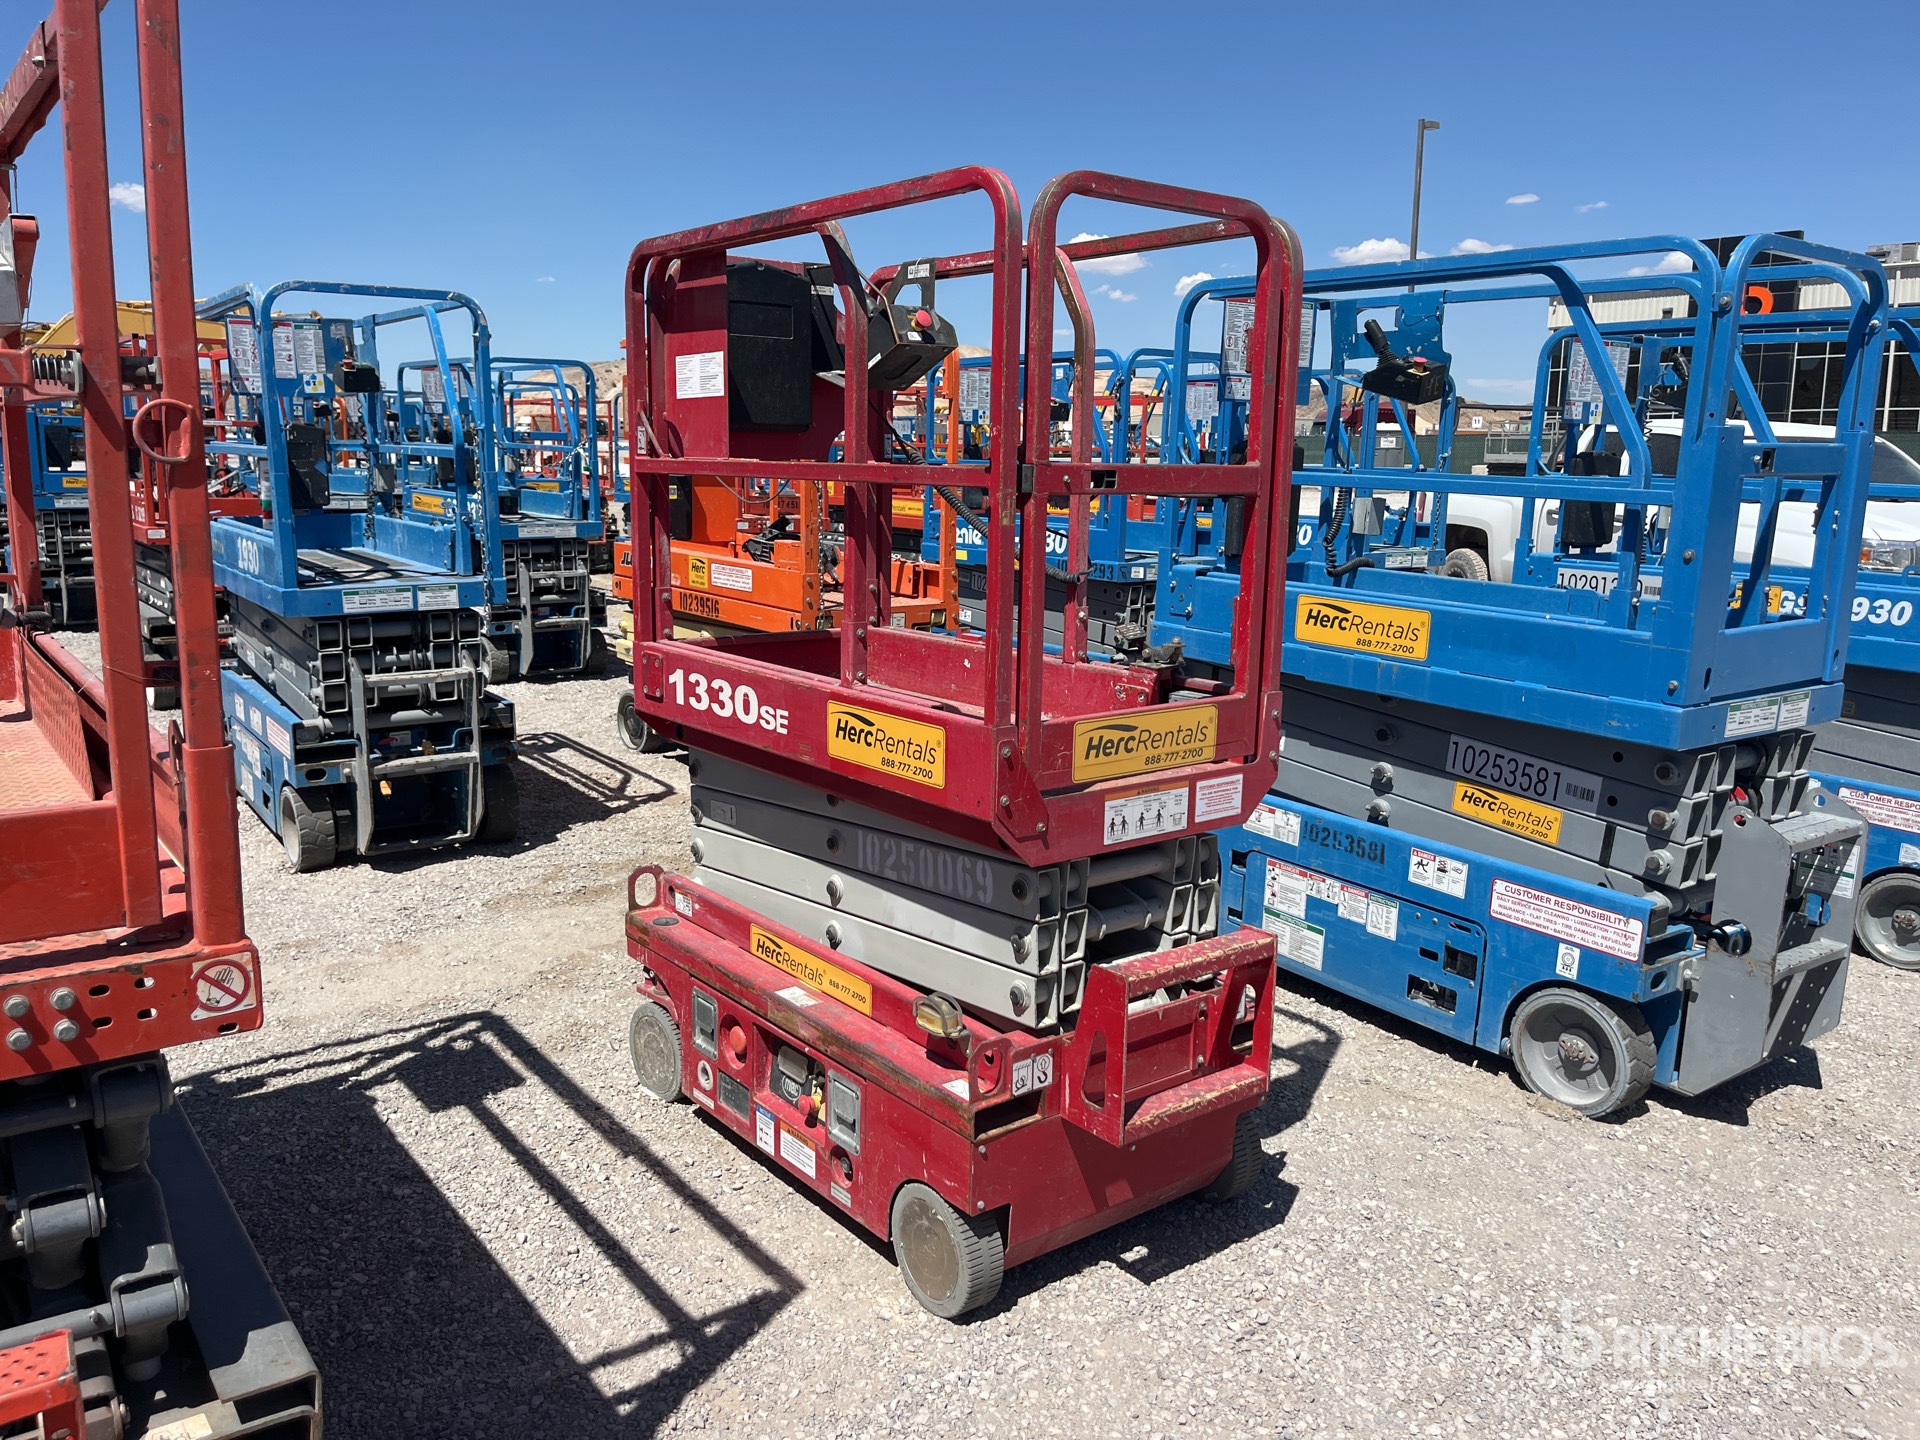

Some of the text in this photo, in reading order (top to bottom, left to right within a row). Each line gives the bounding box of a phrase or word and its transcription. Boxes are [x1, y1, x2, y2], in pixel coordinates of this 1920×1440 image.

[237, 536, 260, 576] 1930
[621, 551, 632, 567] JL
[679, 591, 720, 618] 10239516
[1355, 637, 1415, 654] 888-777-2700
[880, 756, 934, 780] 888-777-2700
[1144, 747, 1204, 766] 888-777-2700
[1452, 741, 1561, 802] 10253581
[1501, 818, 1549, 839] 888-777-2700
[857, 830, 994, 905] 10250069
[1280, 863, 1300, 875] DANGER
[1347, 886, 1366, 897] DANGER
[1496, 895, 1510, 904] DAILY
[1511, 898, 1531, 910] SERVICE
[1532, 906, 1543, 914] AND
[1544, 909, 1570, 922] CLEANING
[1573, 919, 1609, 934] LUBRICATION
[1504, 885, 1630, 929] CUSTOMER RESPONSIBILITY
[1491, 908, 1513, 920] DAMAGE
[1520, 918, 1550, 931] EQUIPMENT
[1553, 927, 1577, 940] BATTERY
[1580, 936, 1591, 944] ALL
[1591, 940, 1604, 949] OILS
[1604, 944, 1617, 952] AND
[1617, 947, 1637, 959] FLUIDS
[1498, 903, 1632, 949] INSURANCE FLAT TIRES TIRE DAMAGE REFUELING
[828, 978, 867, 1004] 888-777-2700
